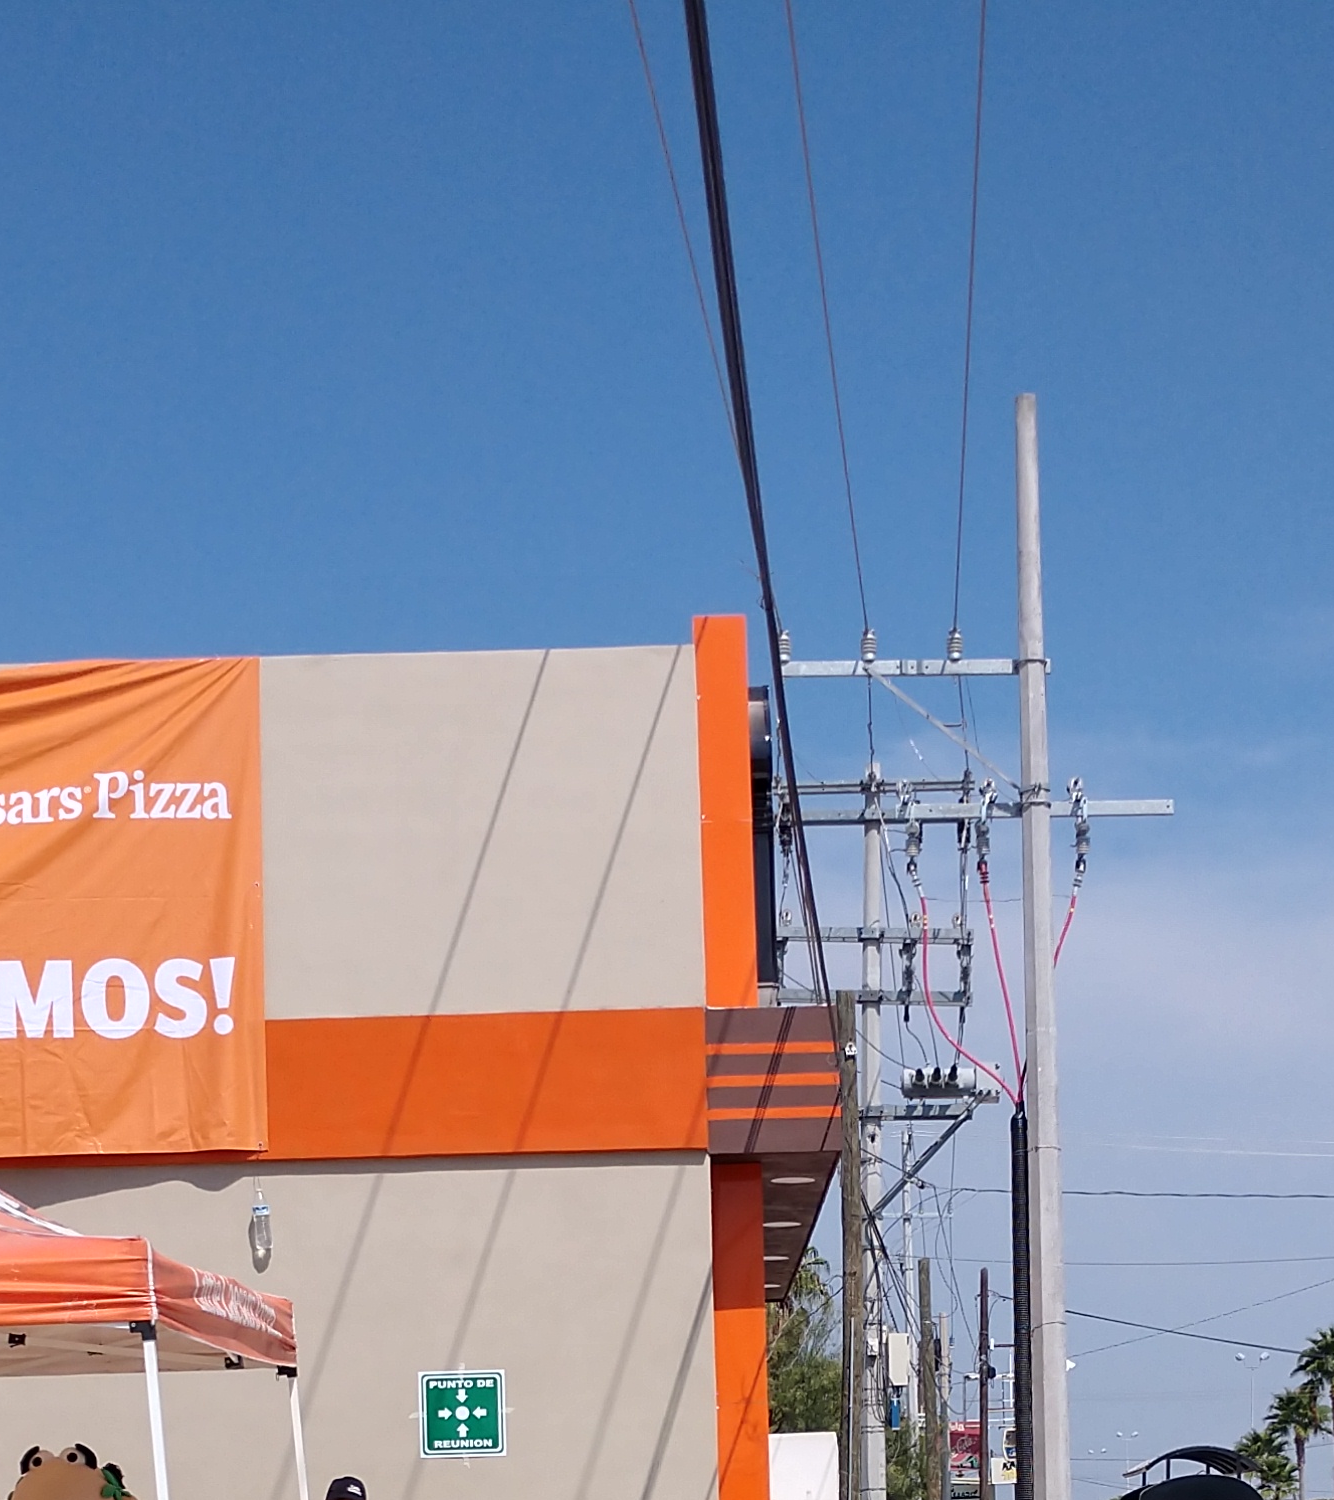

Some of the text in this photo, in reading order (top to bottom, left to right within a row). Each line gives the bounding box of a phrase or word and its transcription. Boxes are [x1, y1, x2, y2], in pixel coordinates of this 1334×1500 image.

[92, 770, 233, 820] Pizza
[429, 1379, 494, 1389] PUNTO DE
[434, 1439, 493, 1449] REUNION
